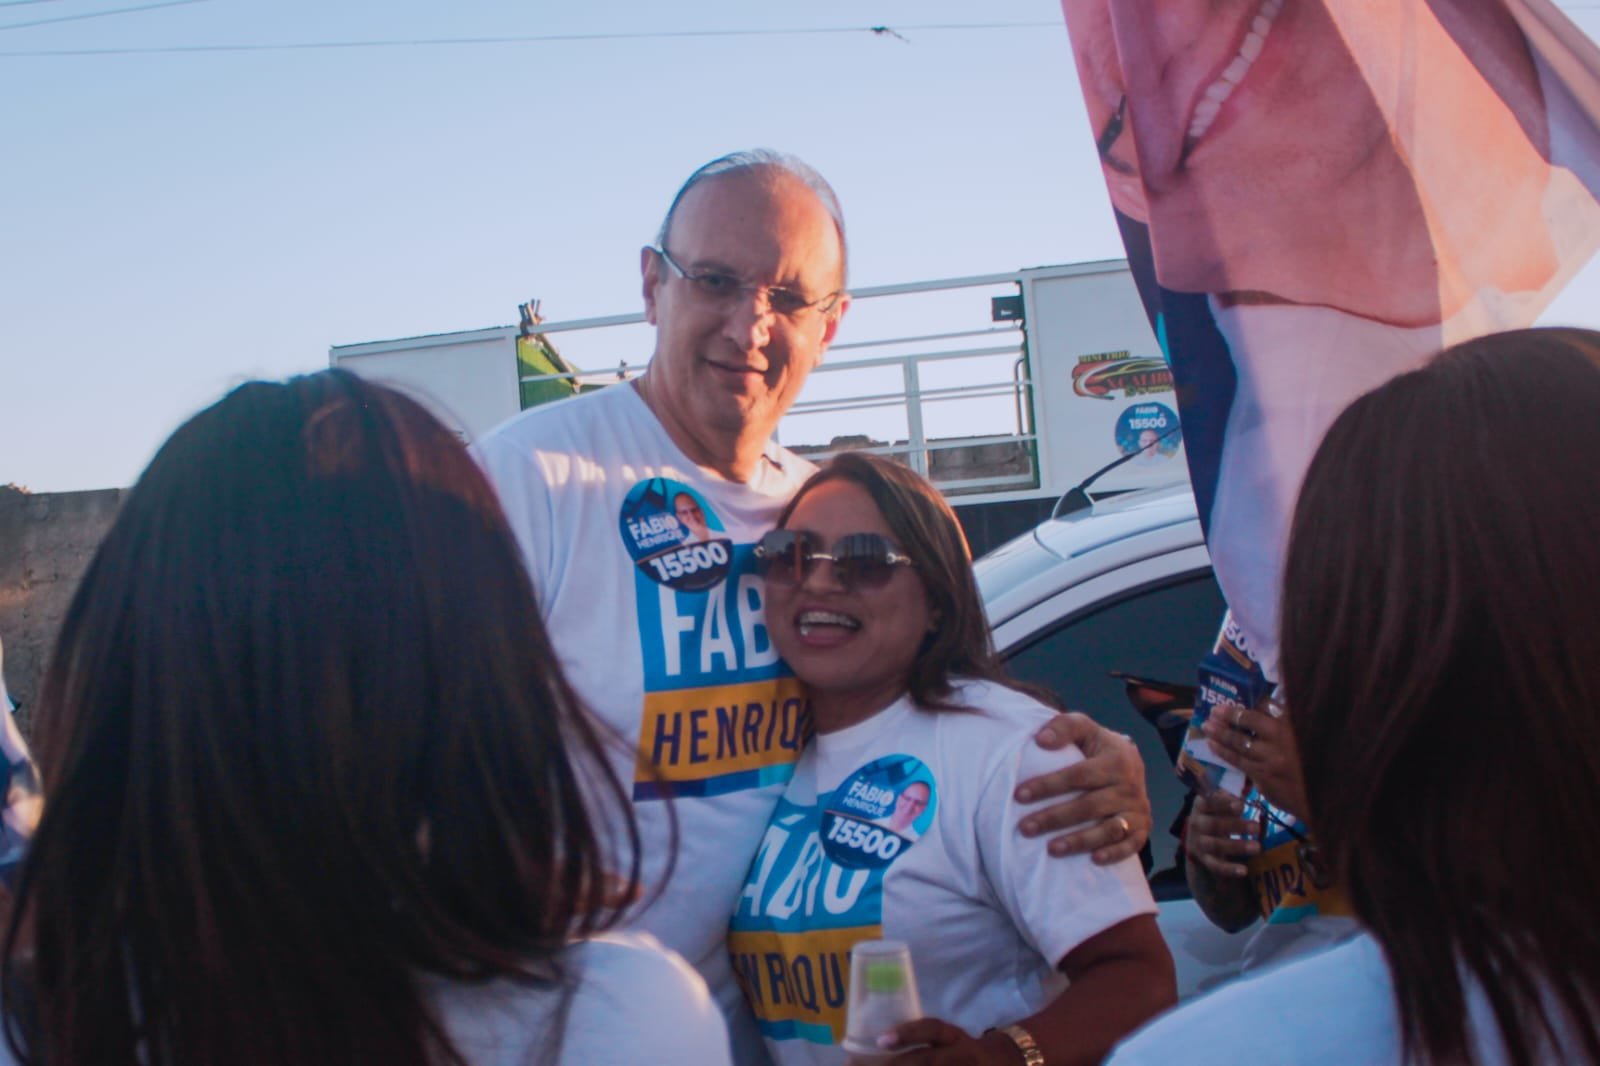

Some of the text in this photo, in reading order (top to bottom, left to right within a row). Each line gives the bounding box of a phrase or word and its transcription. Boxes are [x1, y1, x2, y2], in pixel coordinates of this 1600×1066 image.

[1128, 416, 1167, 429] 15500
[649, 542, 728, 581] 15500
[652, 697, 803, 767] HENRIQ
[828, 815, 901, 860] 15500
[735, 814, 871, 920] ÁBIO
